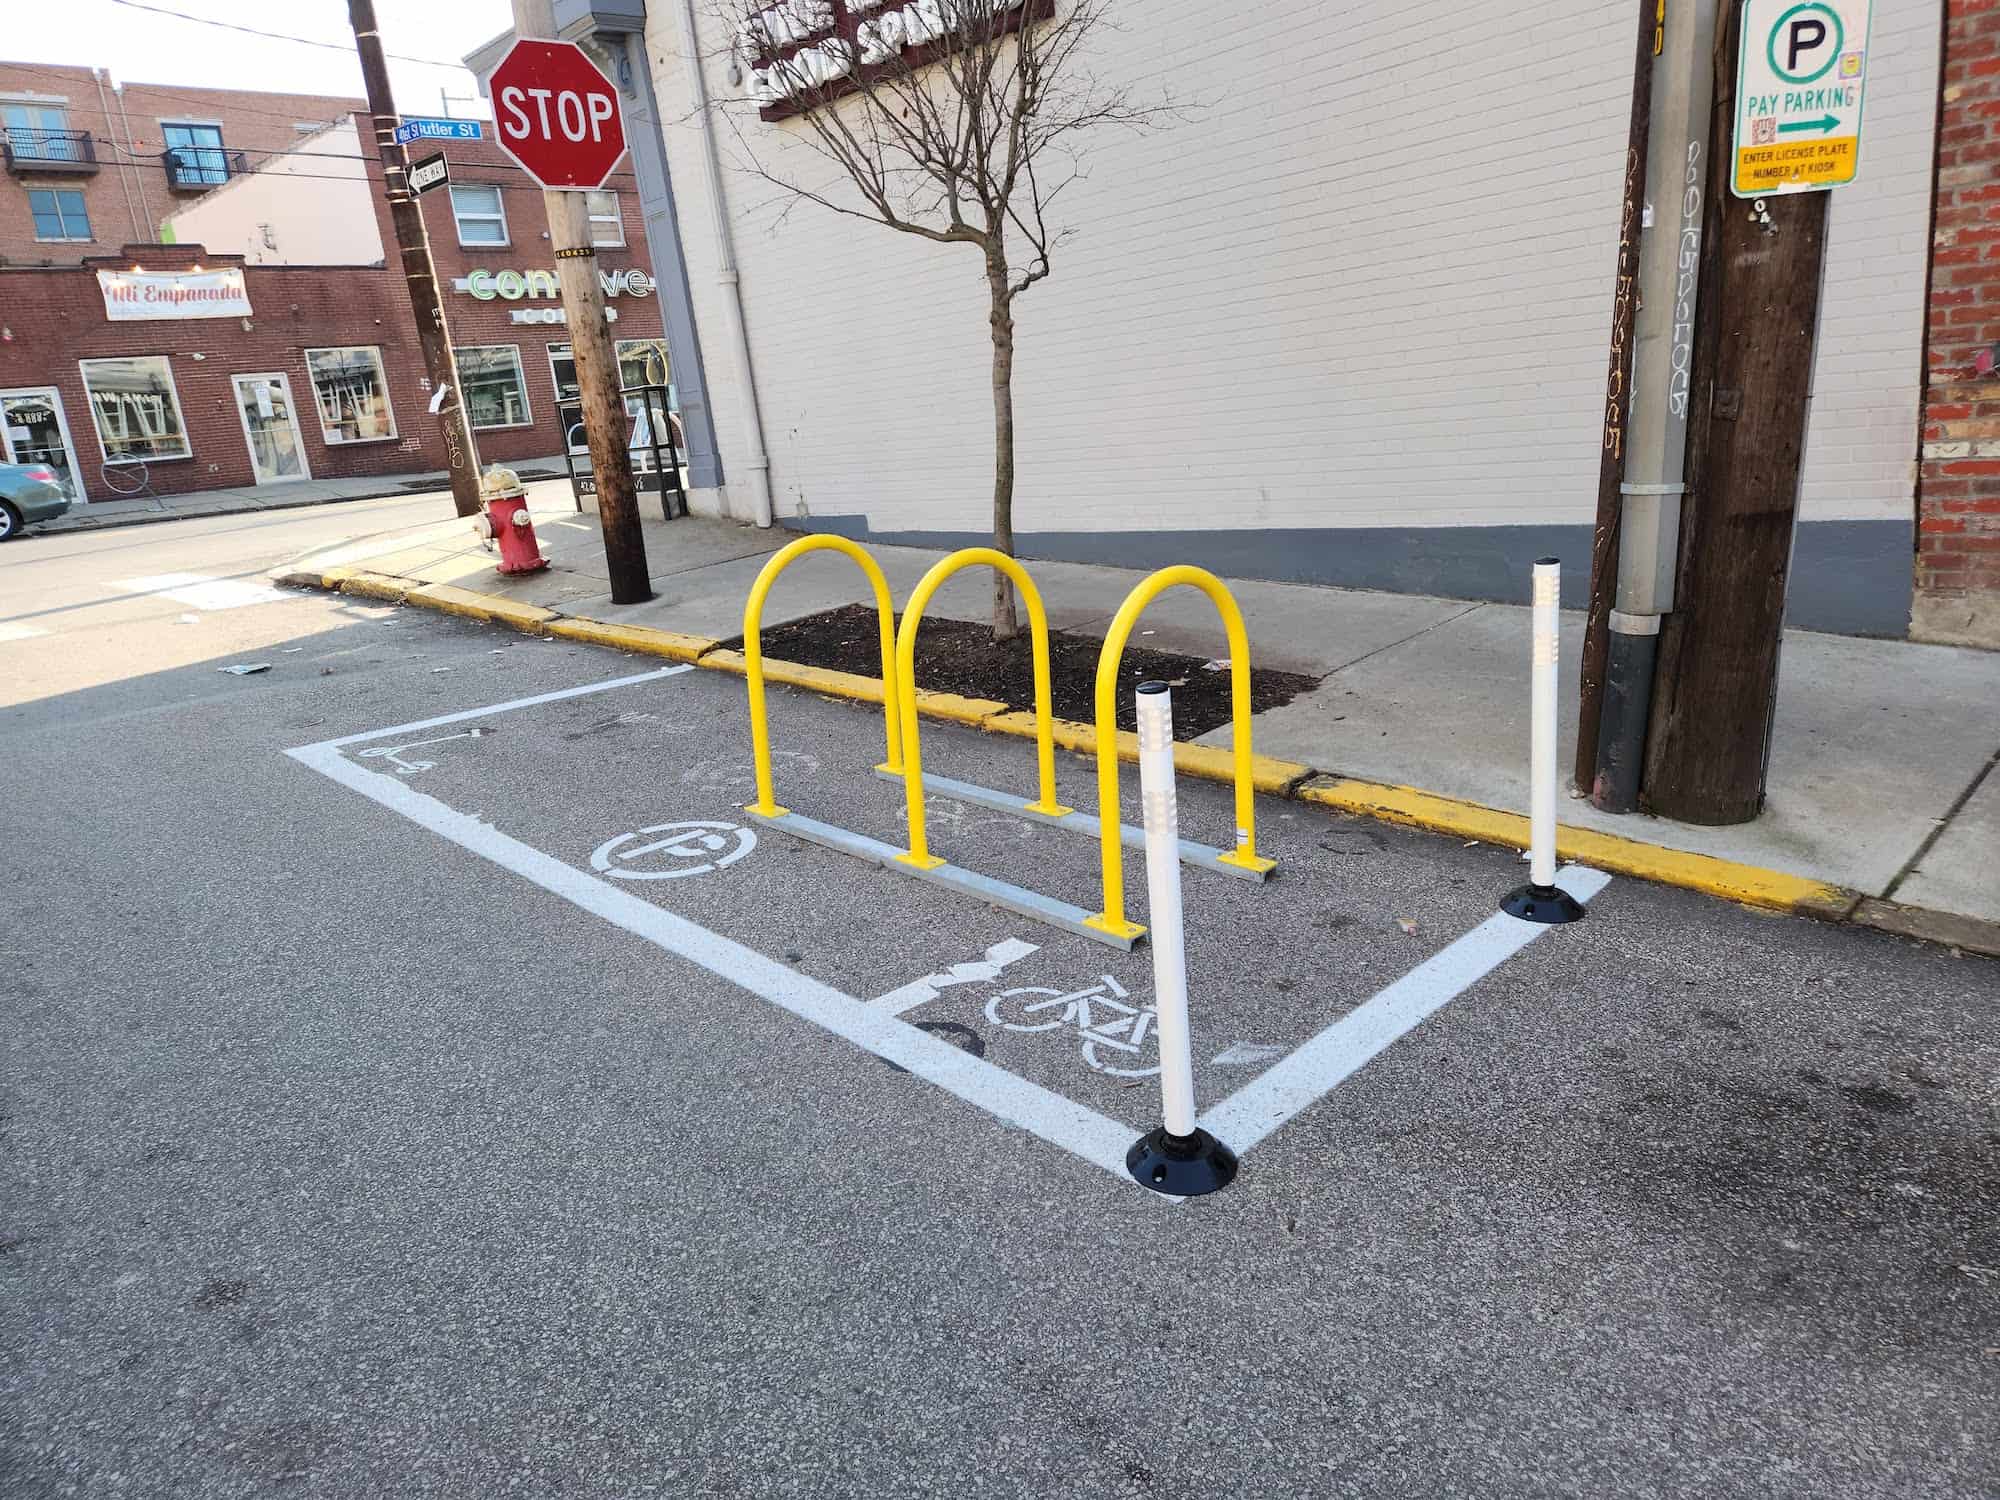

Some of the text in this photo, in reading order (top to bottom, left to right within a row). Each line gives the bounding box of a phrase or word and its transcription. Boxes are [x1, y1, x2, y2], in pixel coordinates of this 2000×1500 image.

[1788, 19, 1826, 70] P
[501, 86, 613, 143] STOP
[1748, 86, 1854, 118] PAY PARKING
[420, 121, 475, 137] utler St
[1743, 143, 1848, 164] ENTER LICENSE PLATE
[1753, 165, 1791, 179] NUMBER
[1808, 161, 1835, 174] KIOSK
[144, 283, 242, 306] Empanada
[467, 268, 651, 300] conve
